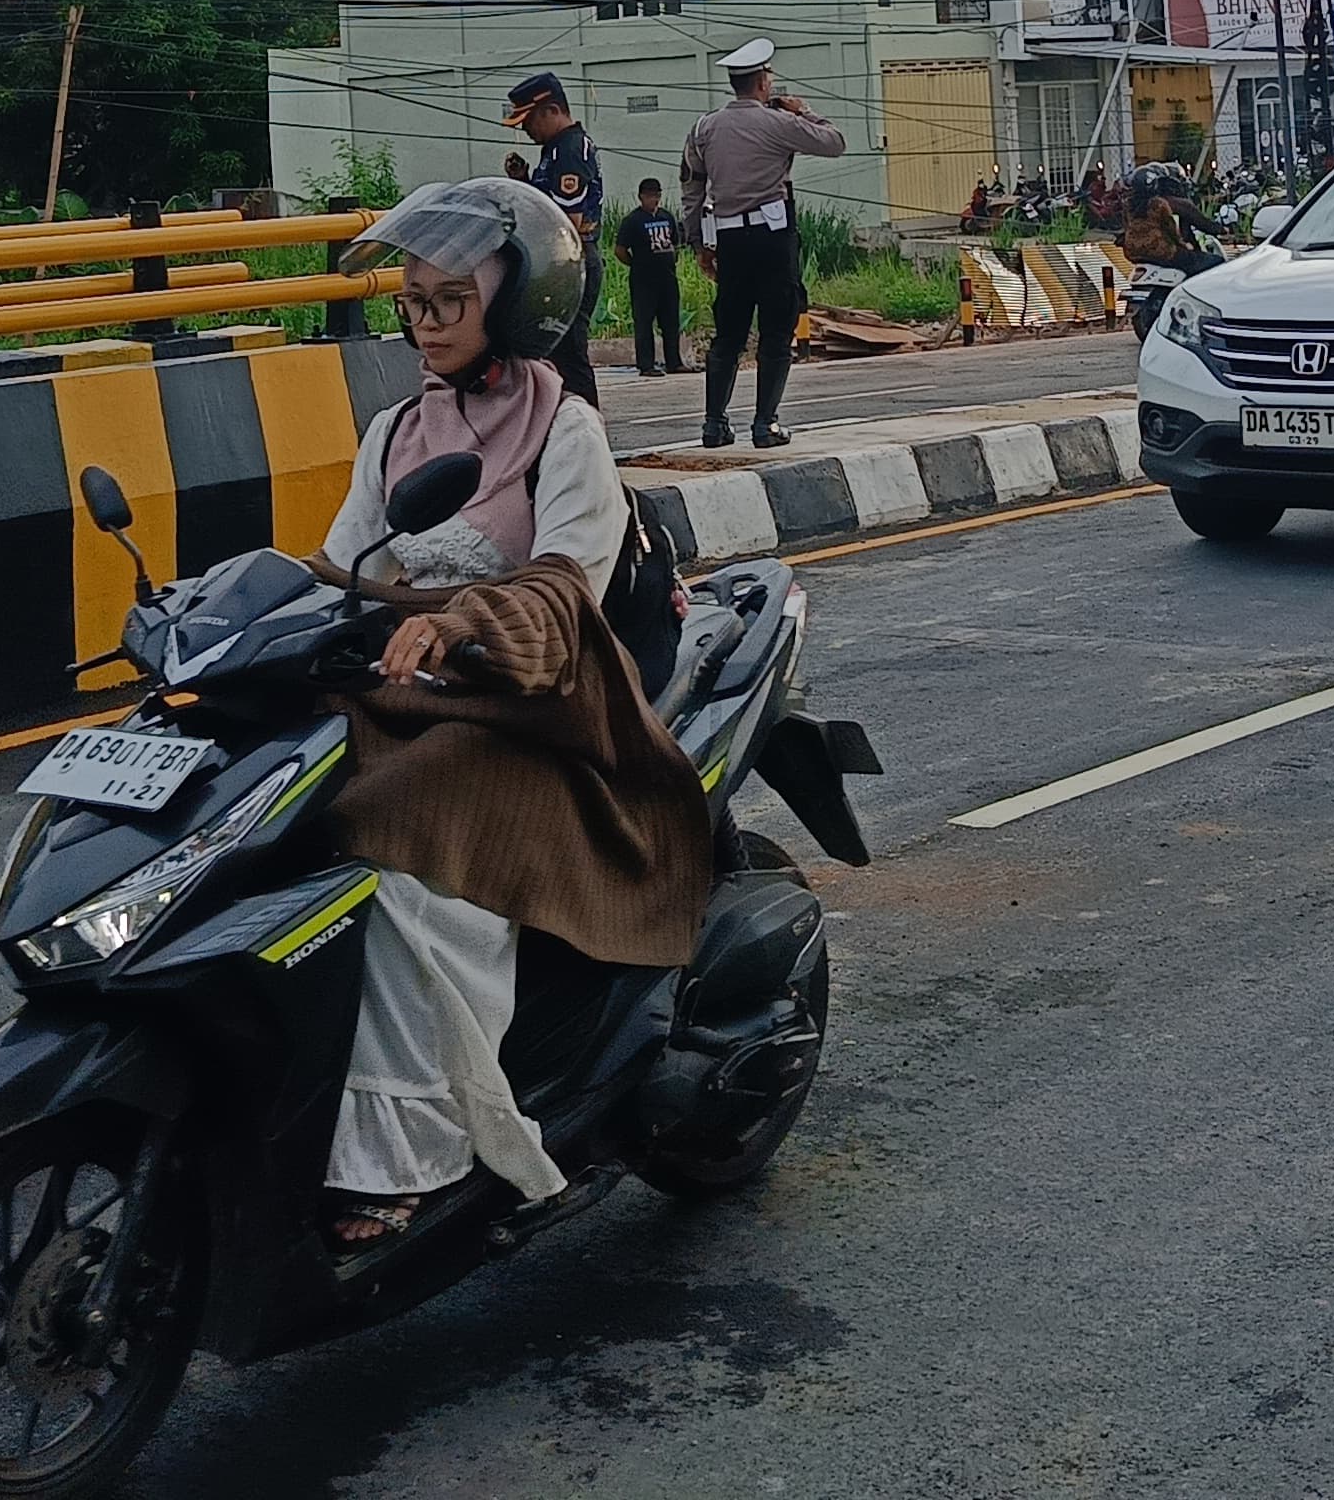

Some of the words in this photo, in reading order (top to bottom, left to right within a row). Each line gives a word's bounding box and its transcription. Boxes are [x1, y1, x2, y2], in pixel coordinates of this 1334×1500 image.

[1245, 410, 1270, 432] DA
[1273, 410, 1321, 434] 1435
[52, 734, 93, 760] DA
[85, 736, 152, 767] 6901
[143, 744, 199, 773] PBR
[284, 916, 355, 969] HONDA
